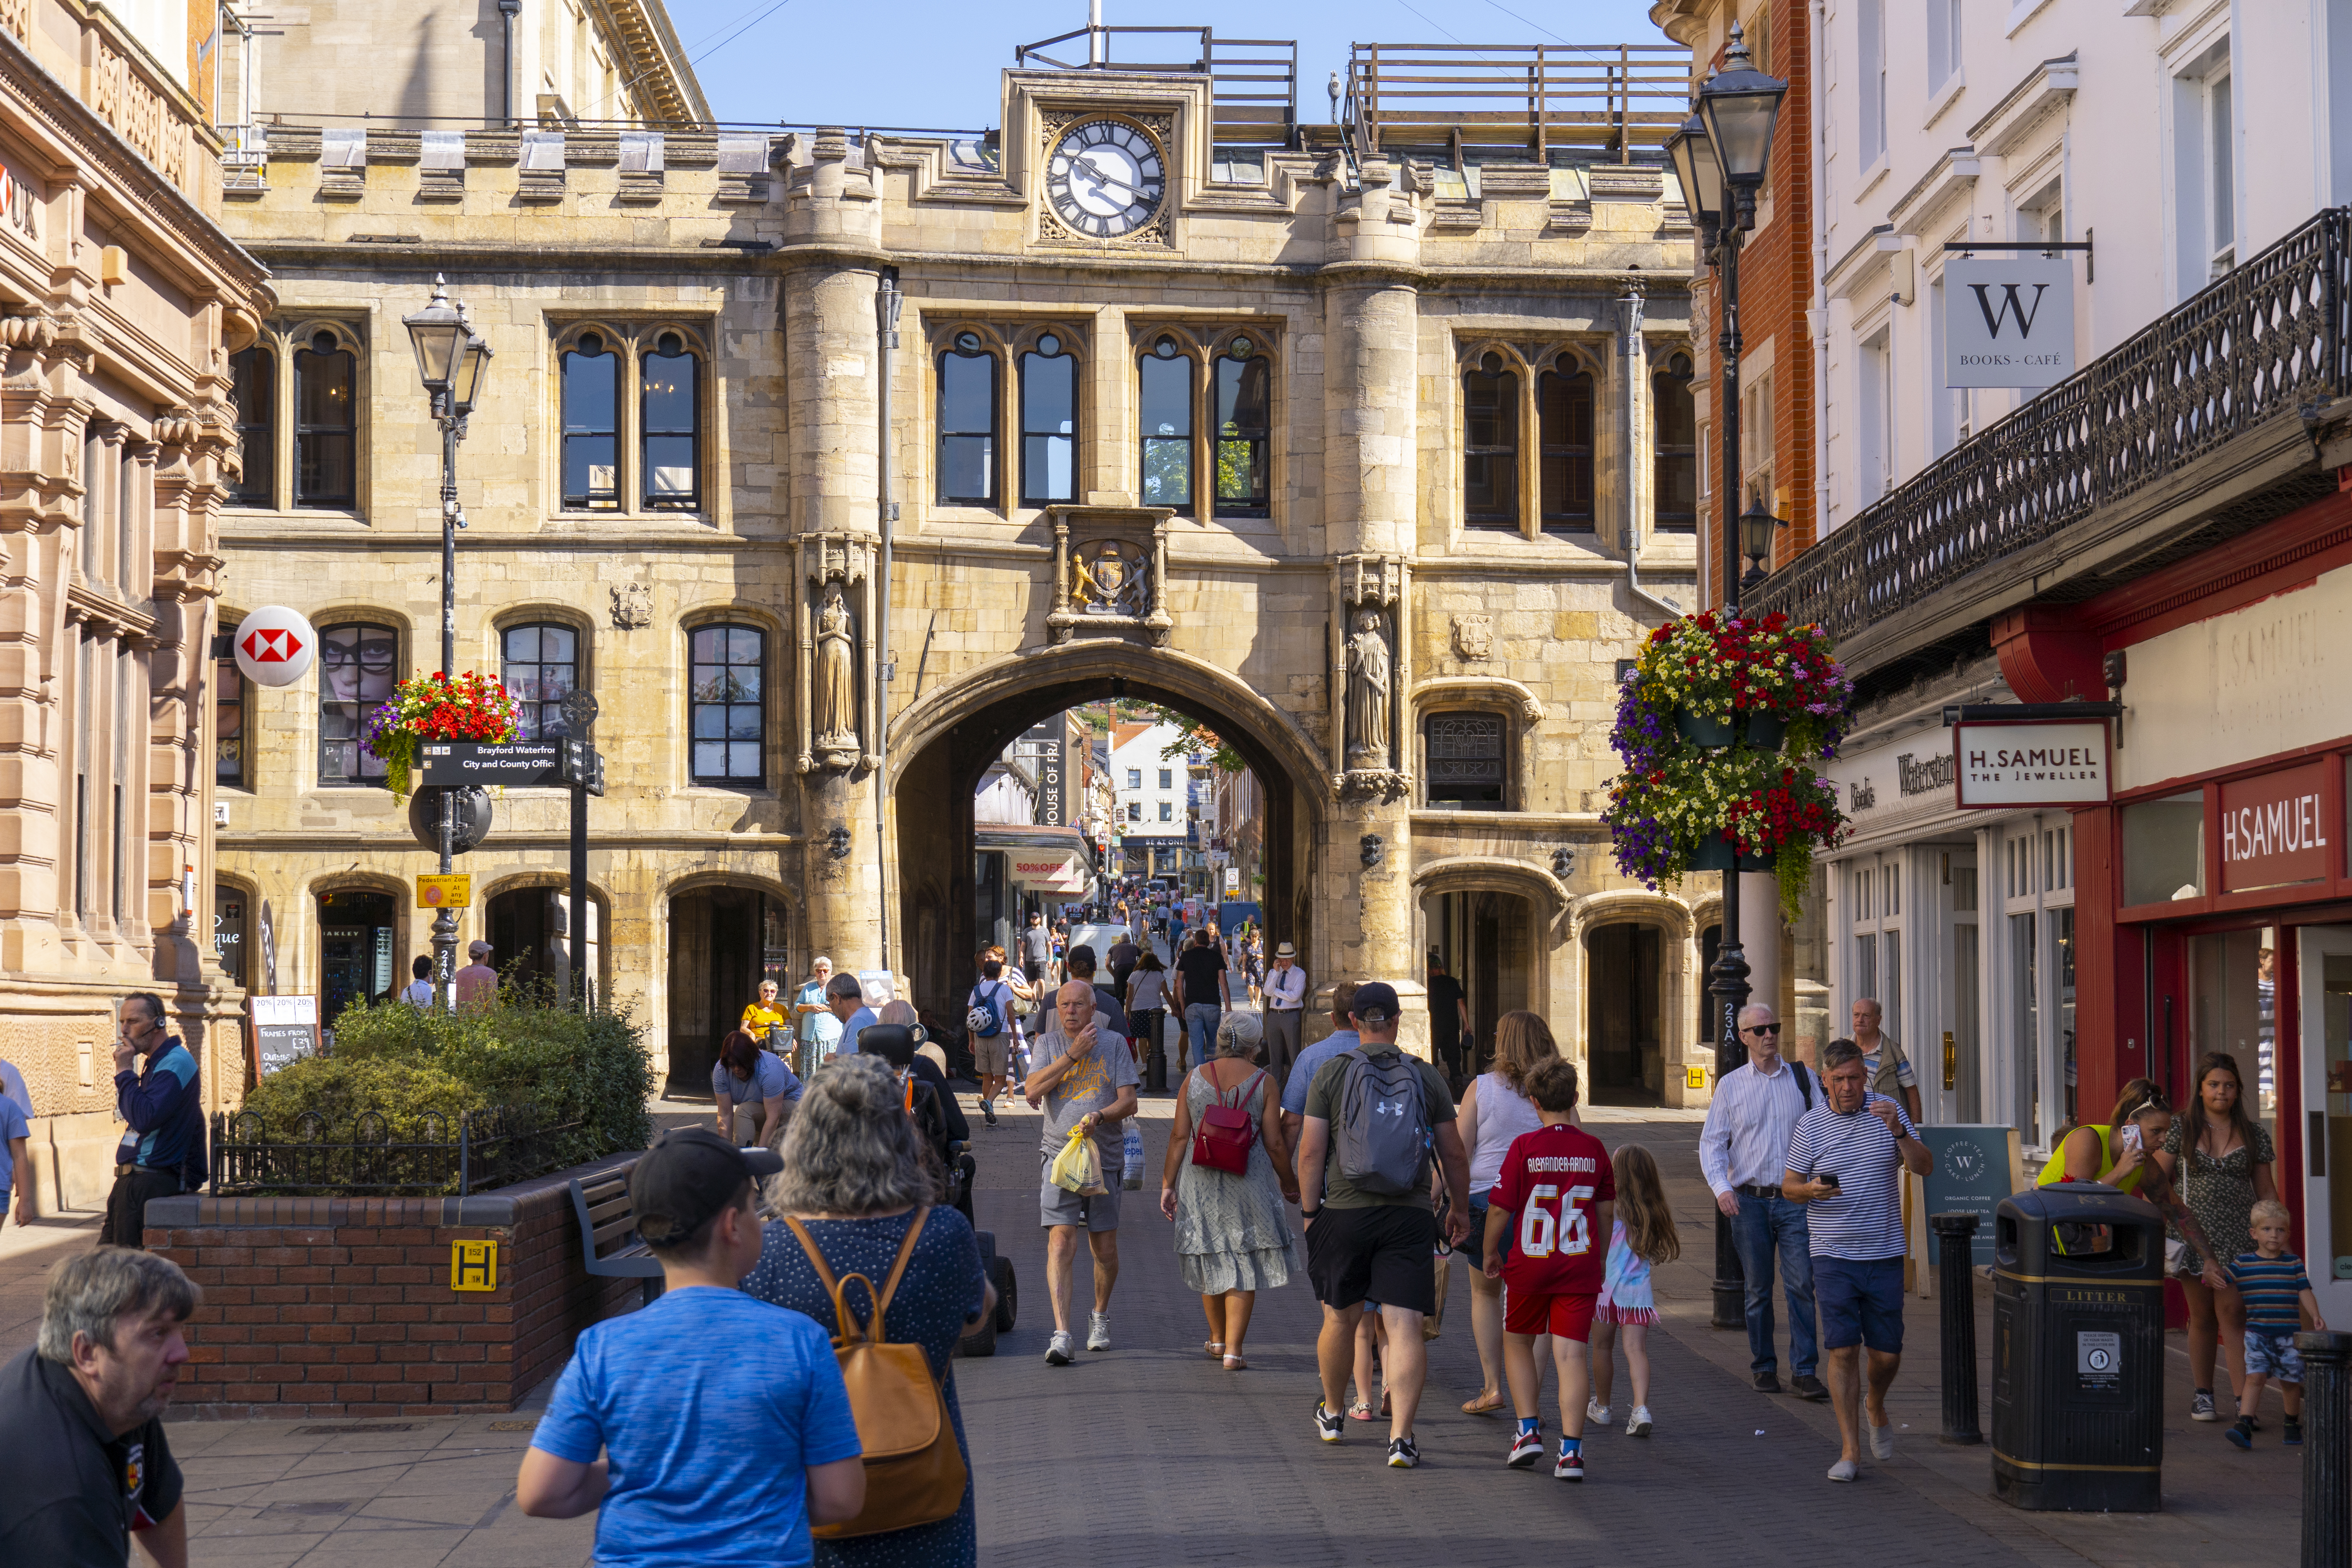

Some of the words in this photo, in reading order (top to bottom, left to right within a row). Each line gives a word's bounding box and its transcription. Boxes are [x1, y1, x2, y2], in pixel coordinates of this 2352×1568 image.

[1967, 284, 2050, 339] W
[1960, 355, 2011, 365] BOOKS
[2024, 352, 2061, 365] CAFÉ
[477, 746, 514, 756] Brayford
[1970, 748, 2096, 768] H.SAMUEL
[463, 760, 480, 770] City
[500, 760, 530, 770] County
[1047, 766, 1058, 784] OF
[1896, 751, 1955, 798] Waterston
[1971, 773, 2000, 782] THE
[2015, 771, 2096, 781] JEWELLER
[1850, 776, 1875, 813] Books
[2223, 793, 2327, 862] H.SAMUEL
[260, 1027, 286, 1037] FRAMES
[292, 1038, 310, 1049] £39
[1691, 1070, 1702, 1085] H
[1944, 1141, 1968, 1158] COFFEE
[1973, 1145, 1983, 1158] TEA
[1955, 1156, 1973, 1168] W
[1945, 1163, 1960, 1180] CAKE
[1965, 1163, 1985, 1181] LUNCH
[1521, 1184, 1595, 1258] 66
[458, 1245, 490, 1286] H
[2066, 1291, 2127, 1303] LITTER
